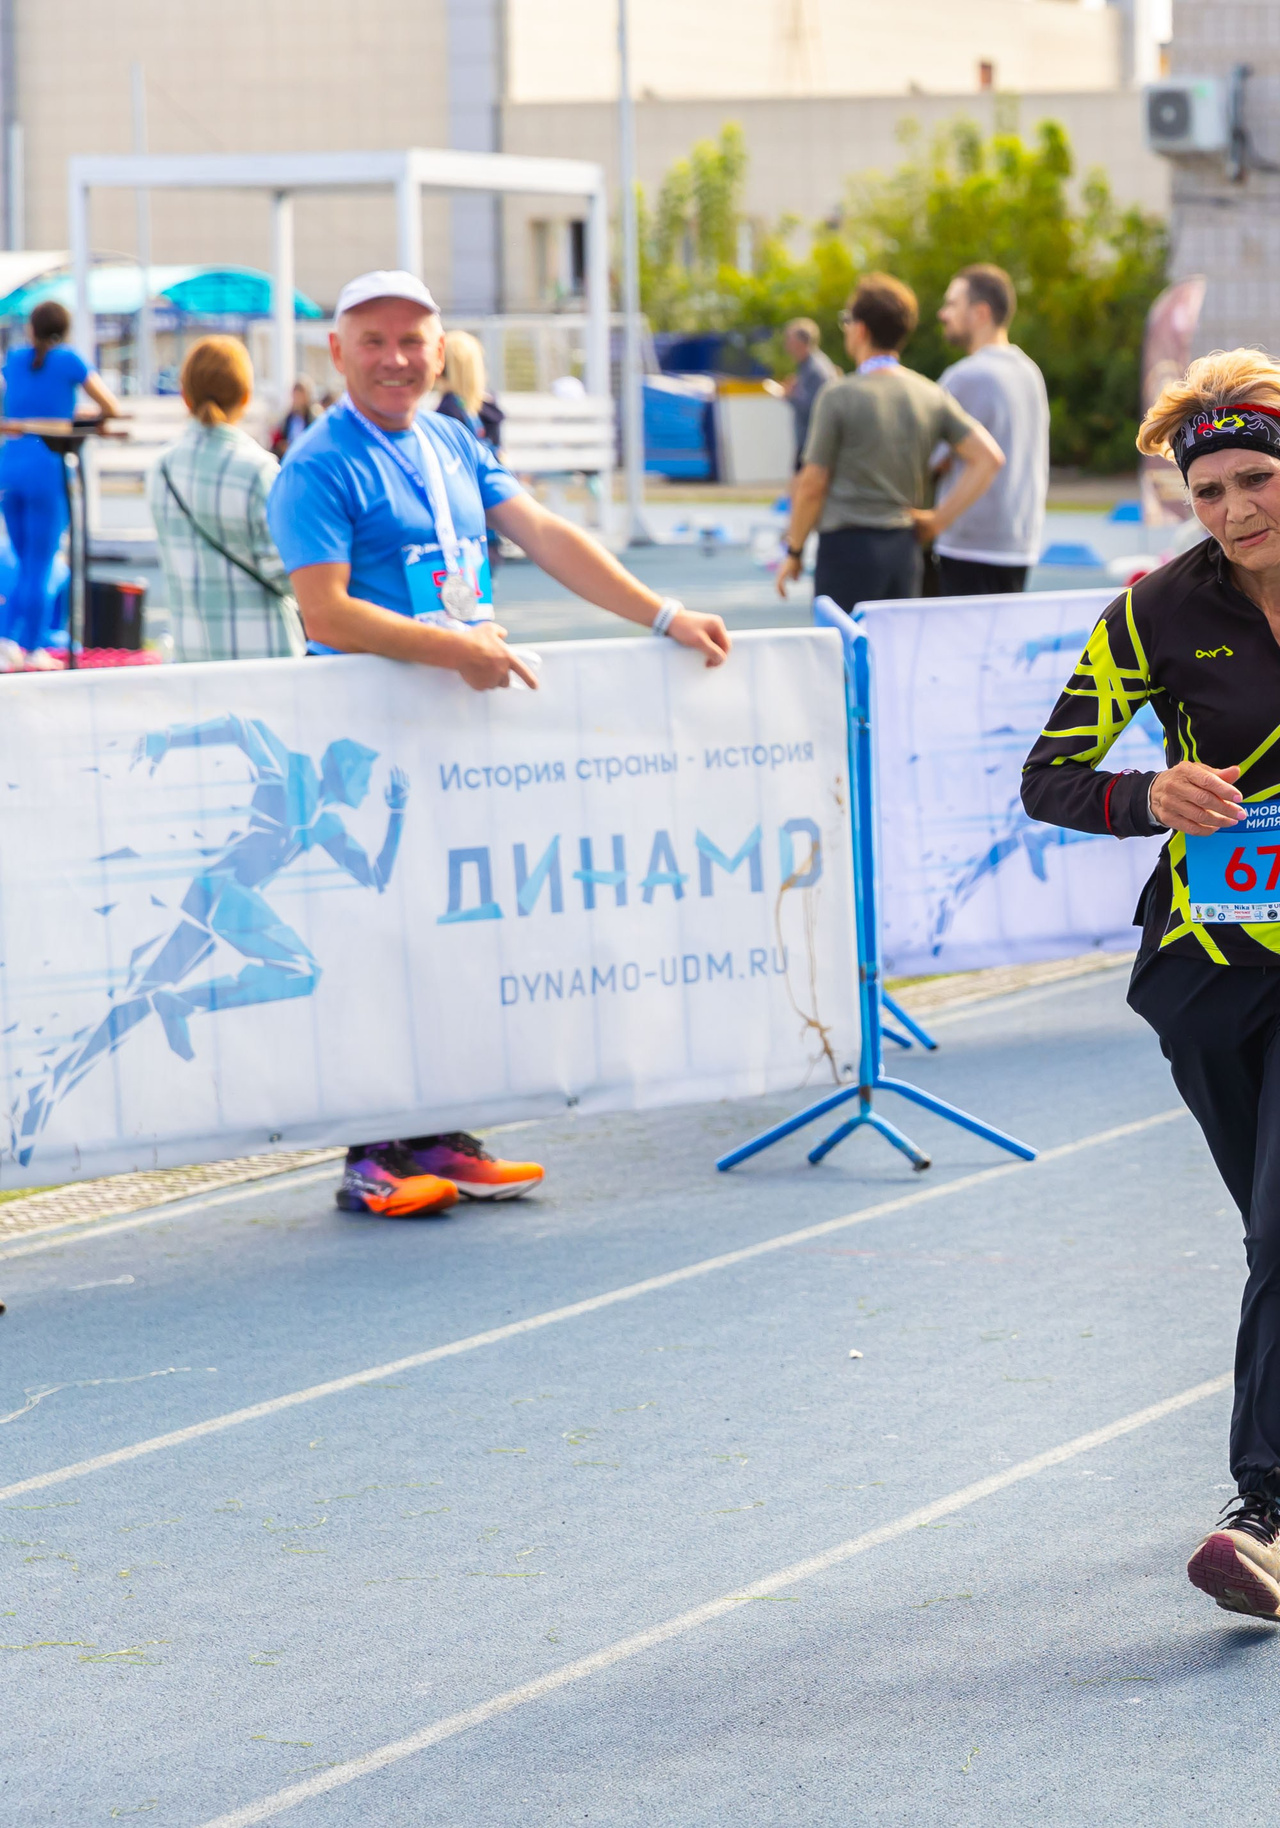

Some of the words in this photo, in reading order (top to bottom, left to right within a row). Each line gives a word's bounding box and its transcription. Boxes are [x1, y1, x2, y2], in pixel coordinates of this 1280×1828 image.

[439, 761, 566, 792] История
[575, 752, 678, 784] страны
[704, 741, 815, 771] история
[436, 816, 823, 925] ДИНАМО
[500, 945, 789, 1006] DYNAMO-UDM.RU
